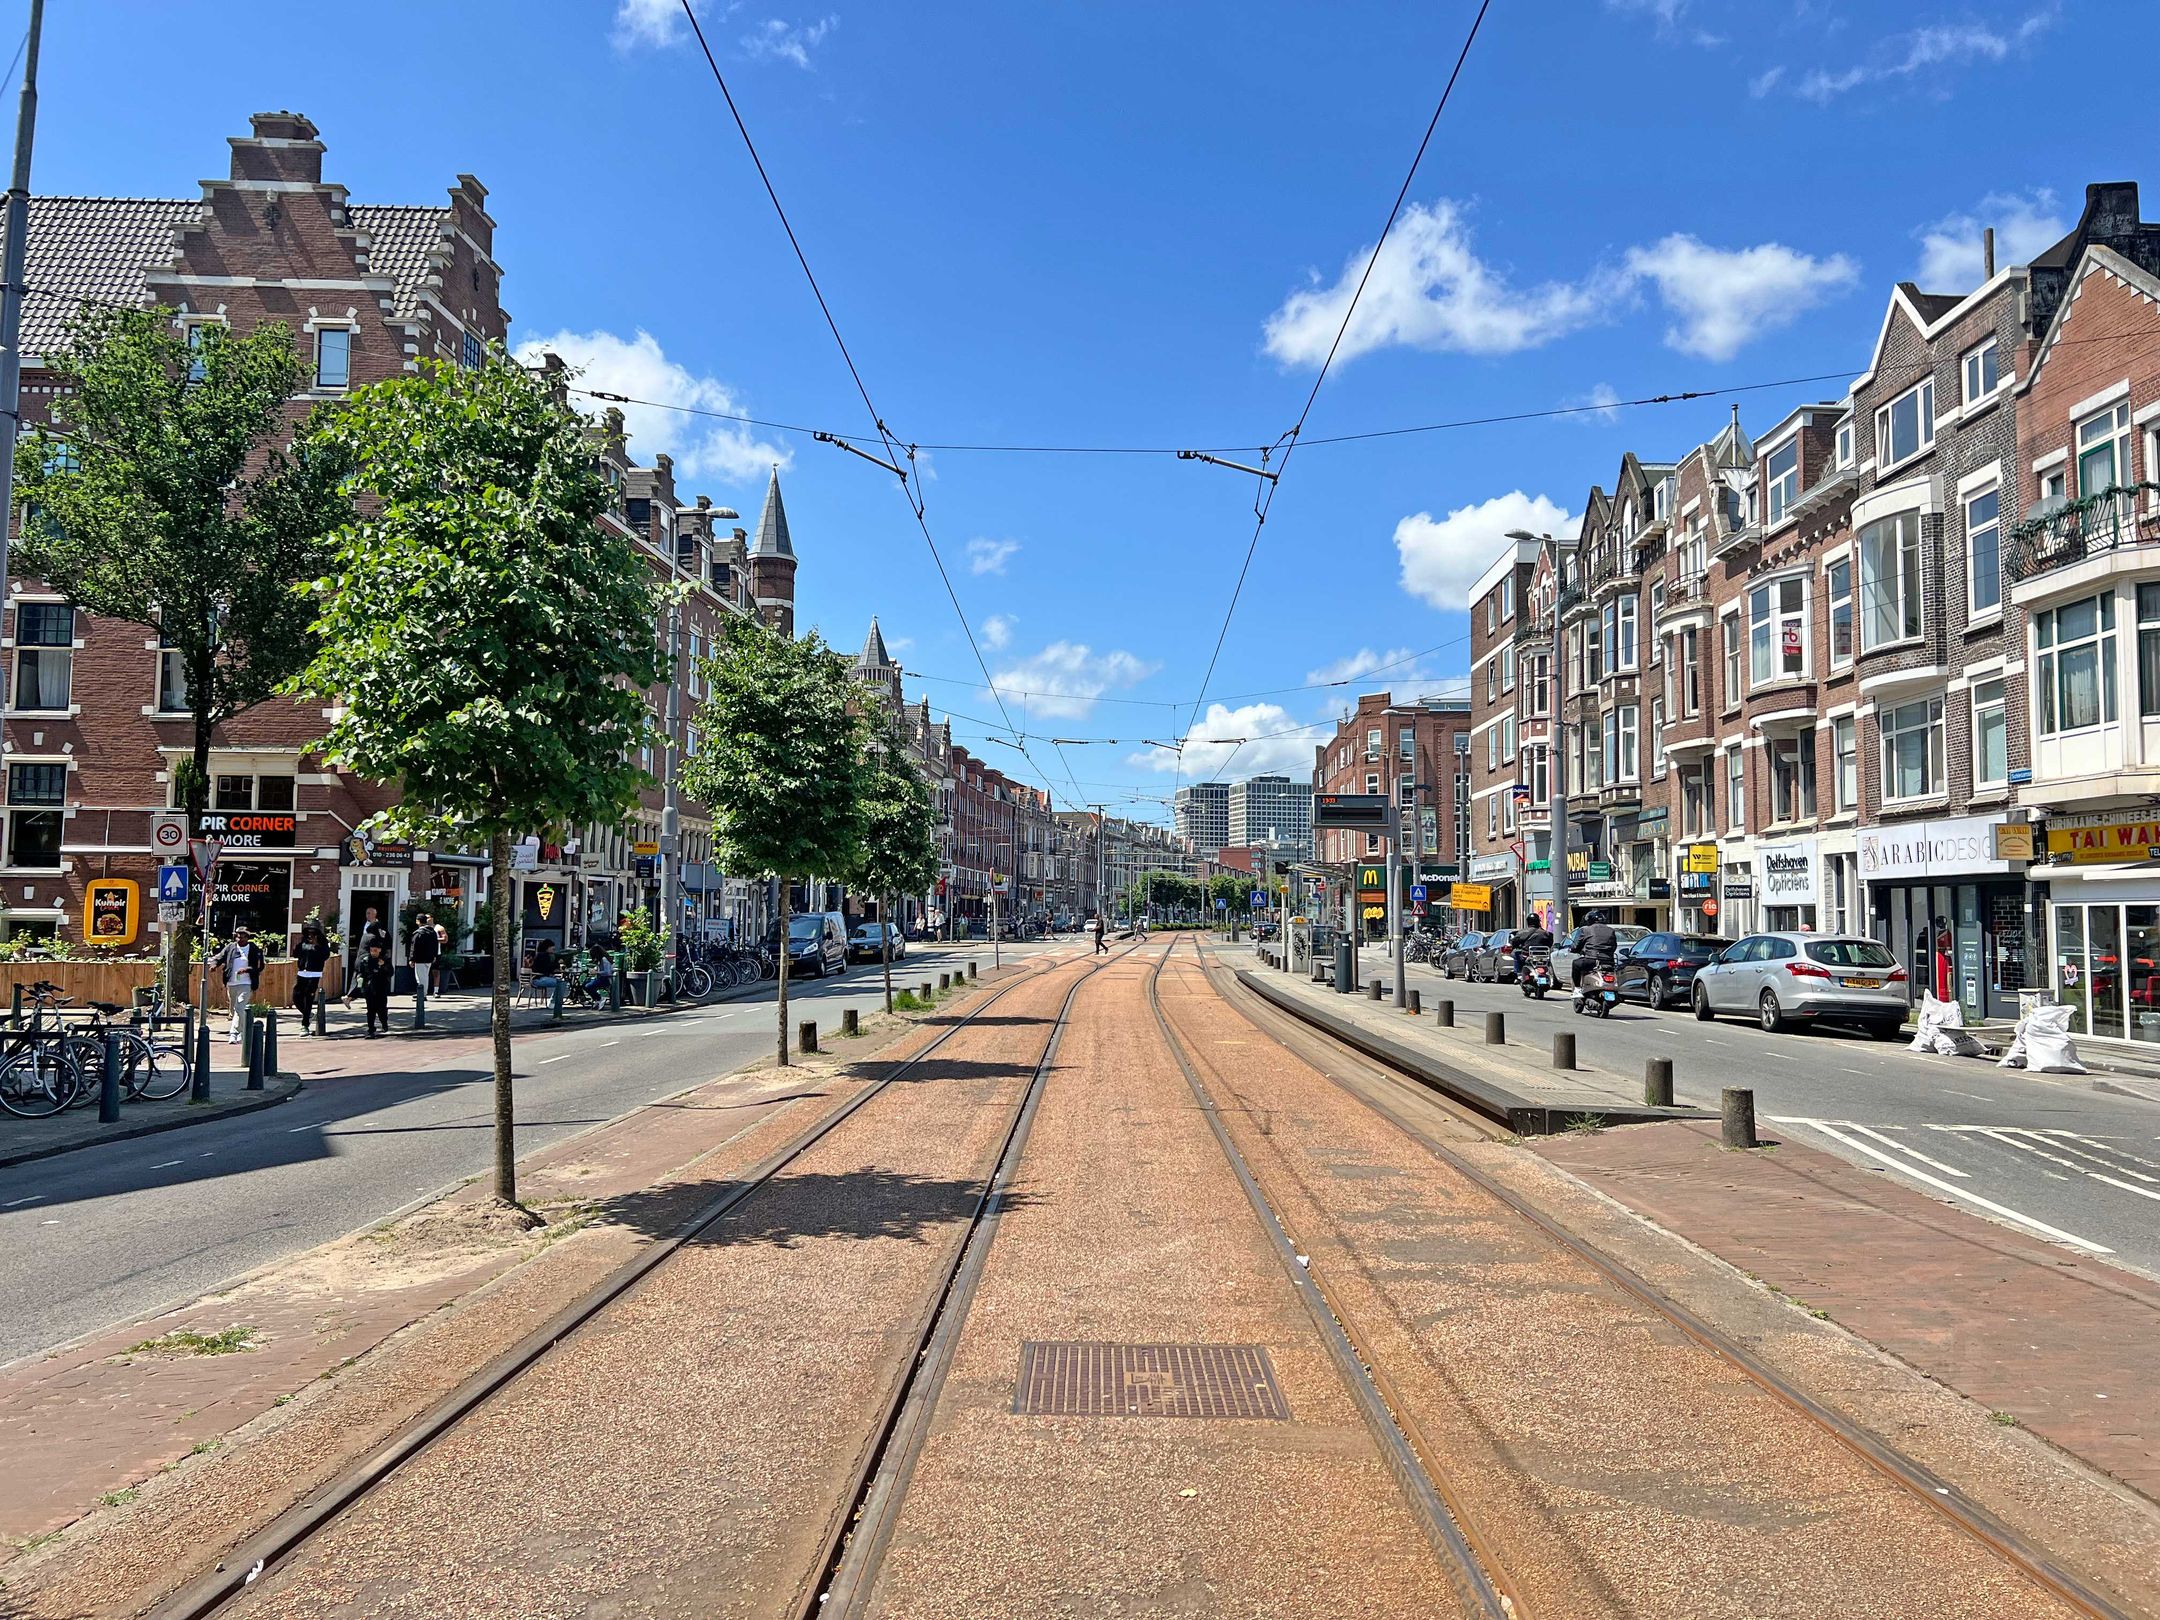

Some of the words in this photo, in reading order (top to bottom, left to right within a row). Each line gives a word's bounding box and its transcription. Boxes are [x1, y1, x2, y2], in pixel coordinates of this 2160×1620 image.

[199, 816, 227, 831] PIR
[229, 816, 295, 832] CORNER
[161, 830, 178, 840] 30
[2070, 829, 2108, 850] TAI
[218, 834, 262, 847] MORE
[1766, 853, 1809, 870] Delfshaven
[191, 884, 229, 893] KUPIR
[231, 884, 270, 893] CORNER
[95, 898, 126, 907] Kumpir
[212, 893, 220, 902] &
[221, 893, 251, 902] MORE
[1704, 901, 1718, 910] ria
